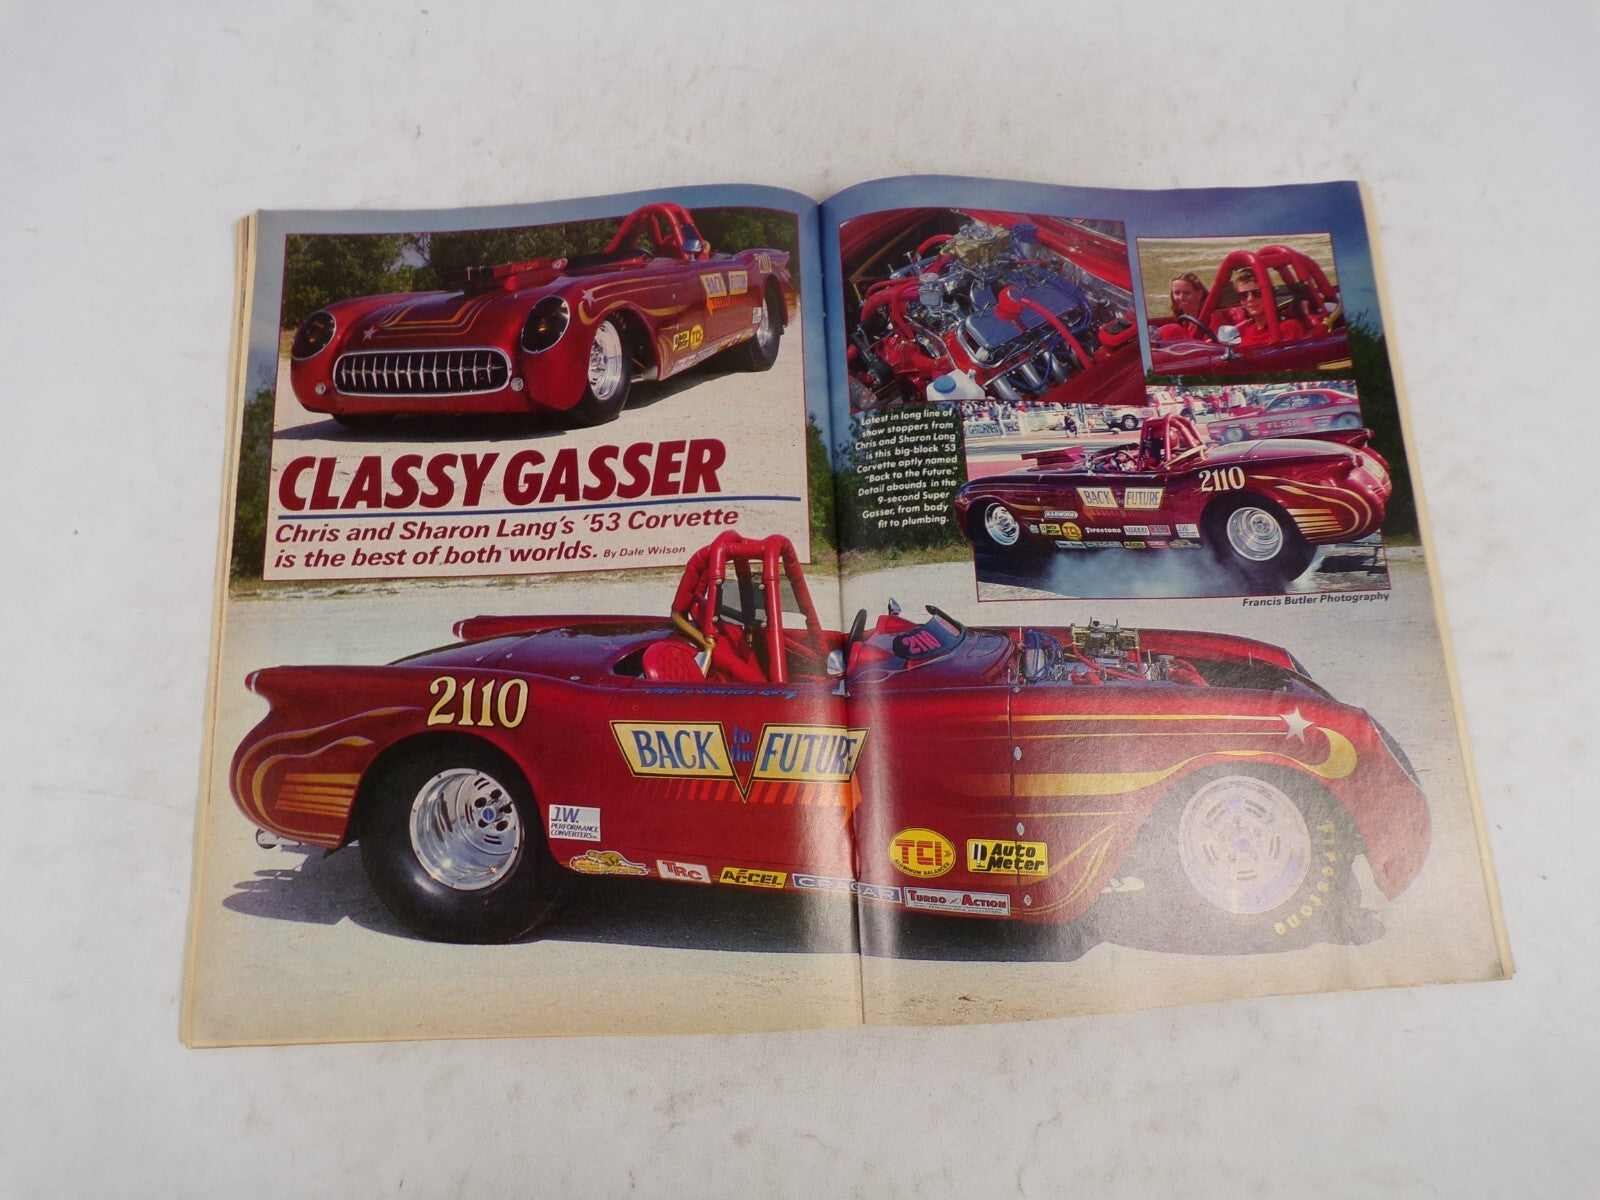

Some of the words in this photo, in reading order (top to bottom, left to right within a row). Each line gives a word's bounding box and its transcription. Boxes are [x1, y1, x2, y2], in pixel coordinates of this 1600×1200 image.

[861, 415, 889, 426] Latest
[901, 411, 922, 420] long
[923, 409, 940, 418] line
[942, 408, 952, 417] of
[862, 428, 885, 438] show
[887, 423, 929, 434] stoppers
[931, 421, 954, 430] from
[855, 441, 877, 450] Chris
[878, 436, 896, 446] and
[898, 433, 931, 444] Sharon
[933, 432, 956, 442] Lang
[865, 452, 873, 460] is
[875, 448, 891, 458] this
[894, 445, 939, 456] big-block
[856, 461, 896, 474] Corvette
[898, 457, 923, 468] aptly
[924, 455, 958, 465] named
[892, 471, 903, 479] to
[905, 468, 920, 477] the
[278, 452, 500, 511] CLASSY
[502, 438, 727, 506] GASSER
[1198, 466, 1246, 492] 2110
[858, 484, 885, 496] Detail
[886, 480, 927, 492] abounds
[931, 479, 939, 487] in
[941, 478, 957, 486] the
[877, 492, 920, 504] 9-second
[922, 491, 950, 501] Super
[1083, 490, 1112, 505] BACK
[1126, 491, 1160, 505] FUTURE
[862, 508, 896, 519] Gasser,
[897, 505, 921, 514] from
[923, 503, 949, 513] body
[275, 523, 341, 543] Chris
[346, 521, 395, 542] and
[399, 521, 490, 541] Sharon
[496, 515, 575, 541] Lang's
[583, 511, 621, 533] '53
[628, 508, 739, 530] Corvette
[878, 520, 888, 529] fit
[890, 519, 900, 527] to
[901, 515, 950, 528] plumbing.
[1085, 526, 1122, 534] Firestone
[275, 549, 297, 568] is
[304, 548, 346, 568] the
[351, 547, 407, 567] best
[412, 545, 443, 565] of
[444, 544, 502, 564] both
[509, 540, 598, 563] worlds.
[603, 549, 617, 559] By
[620, 547, 644, 557] Dale
[647, 546, 686, 555] Wilson
[1242, 597, 1282, 607] Francis
[1284, 595, 1317, 605] Butler
[1319, 592, 1390, 604] Photography
[901, 630, 942, 654] 2110
[427, 676, 528, 728] 2110
[733, 726, 751, 744] to
[631, 730, 721, 771] BACK
[730, 744, 755, 763] the
[759, 732, 858, 774] FUTURE
[551, 806, 580, 824] J.W.
[550, 823, 599, 833] PERFORMANCE
[550, 830, 593, 839] CONVERTERS
[894, 838, 942, 867] TCI
[990, 843, 1036, 858] Auto
[662, 861, 703, 881] TRC
[894, 859, 922, 876] ALUMINUM
[923, 861, 951, 876] BALANCER
[987, 855, 1044, 871] Meter
[722, 869, 783, 886] ACCEL
[908, 890, 947, 904] TURBO
[961, 894, 1007, 908] ACTION
